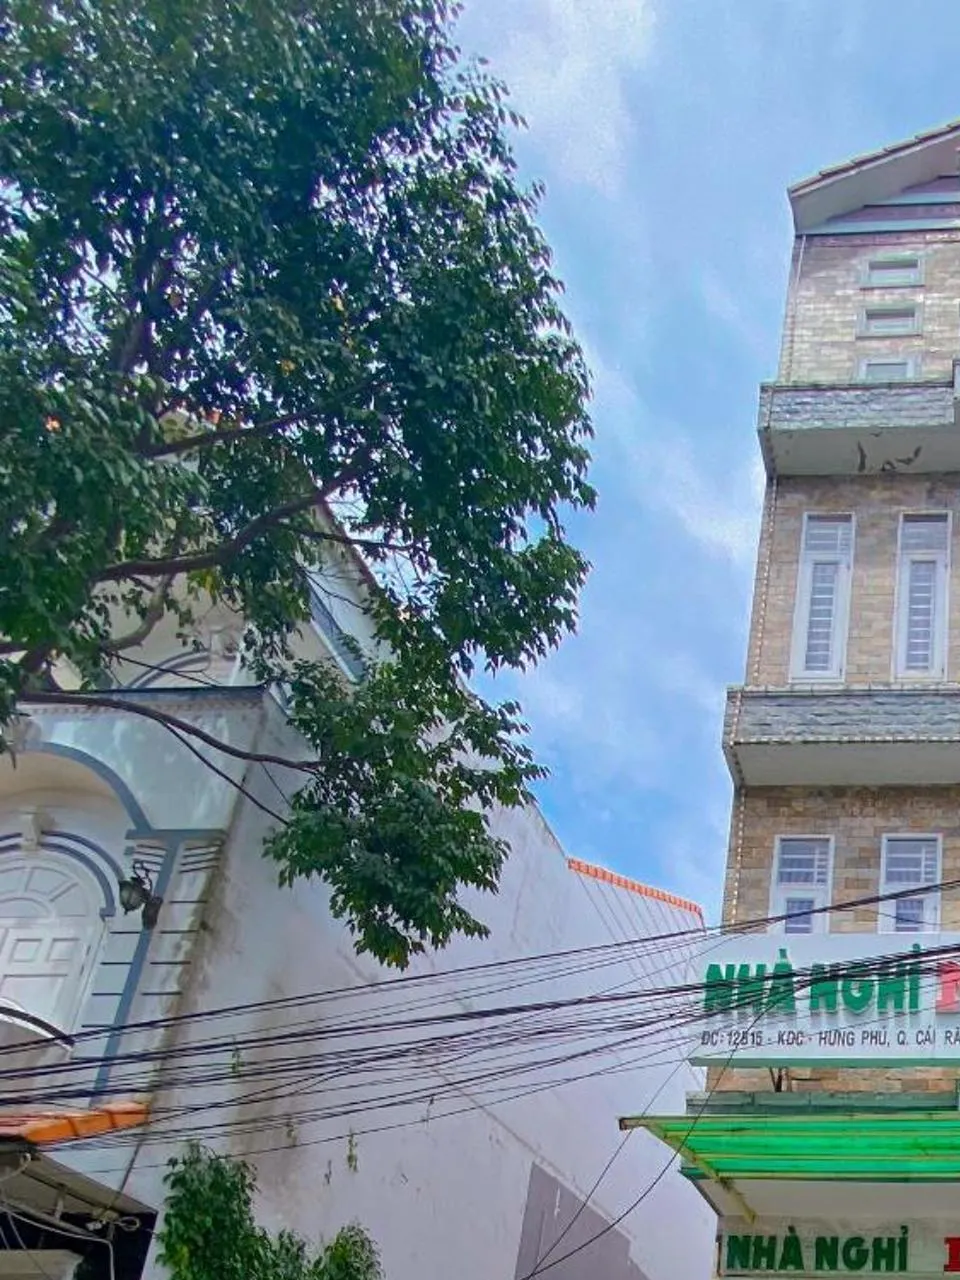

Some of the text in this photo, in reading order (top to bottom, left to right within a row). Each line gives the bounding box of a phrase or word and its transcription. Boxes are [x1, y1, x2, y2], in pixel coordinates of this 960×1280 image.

[704, 948, 796, 1012] NHÀ
[727, 1225, 805, 1271] NHÀ
[815, 1225, 909, 1272] NGHỈ
